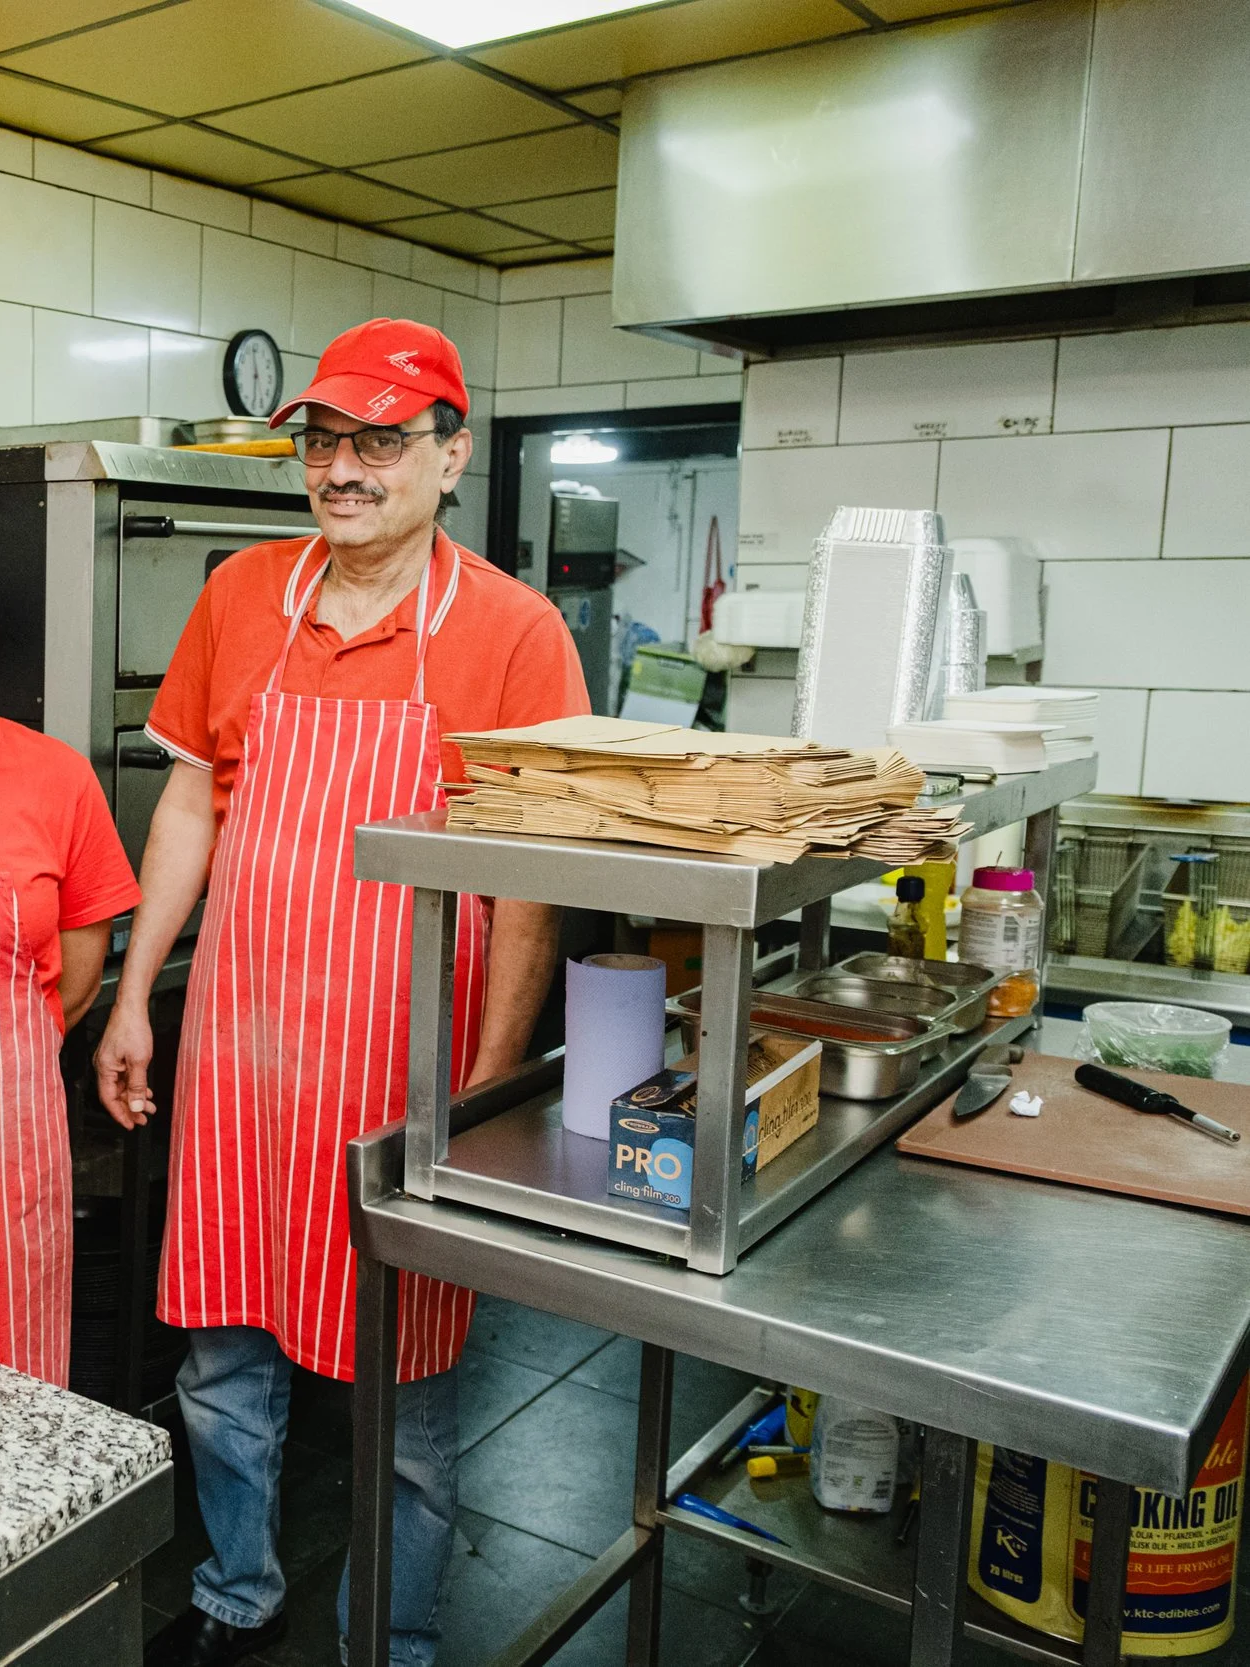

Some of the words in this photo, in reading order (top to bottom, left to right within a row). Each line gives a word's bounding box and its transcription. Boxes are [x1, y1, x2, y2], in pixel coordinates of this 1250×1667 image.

[375, 395, 396, 411] CAP
[616, 1143, 682, 1180] PRO
[614, 1181, 640, 1197] cling
[643, 1185, 662, 1200] film
[664, 1193, 680, 1204] 300
[1213, 1481, 1238, 1524] OIL
[1148, 1564, 1174, 1574] LIFE
[1177, 1560, 1216, 1573] FRYING
